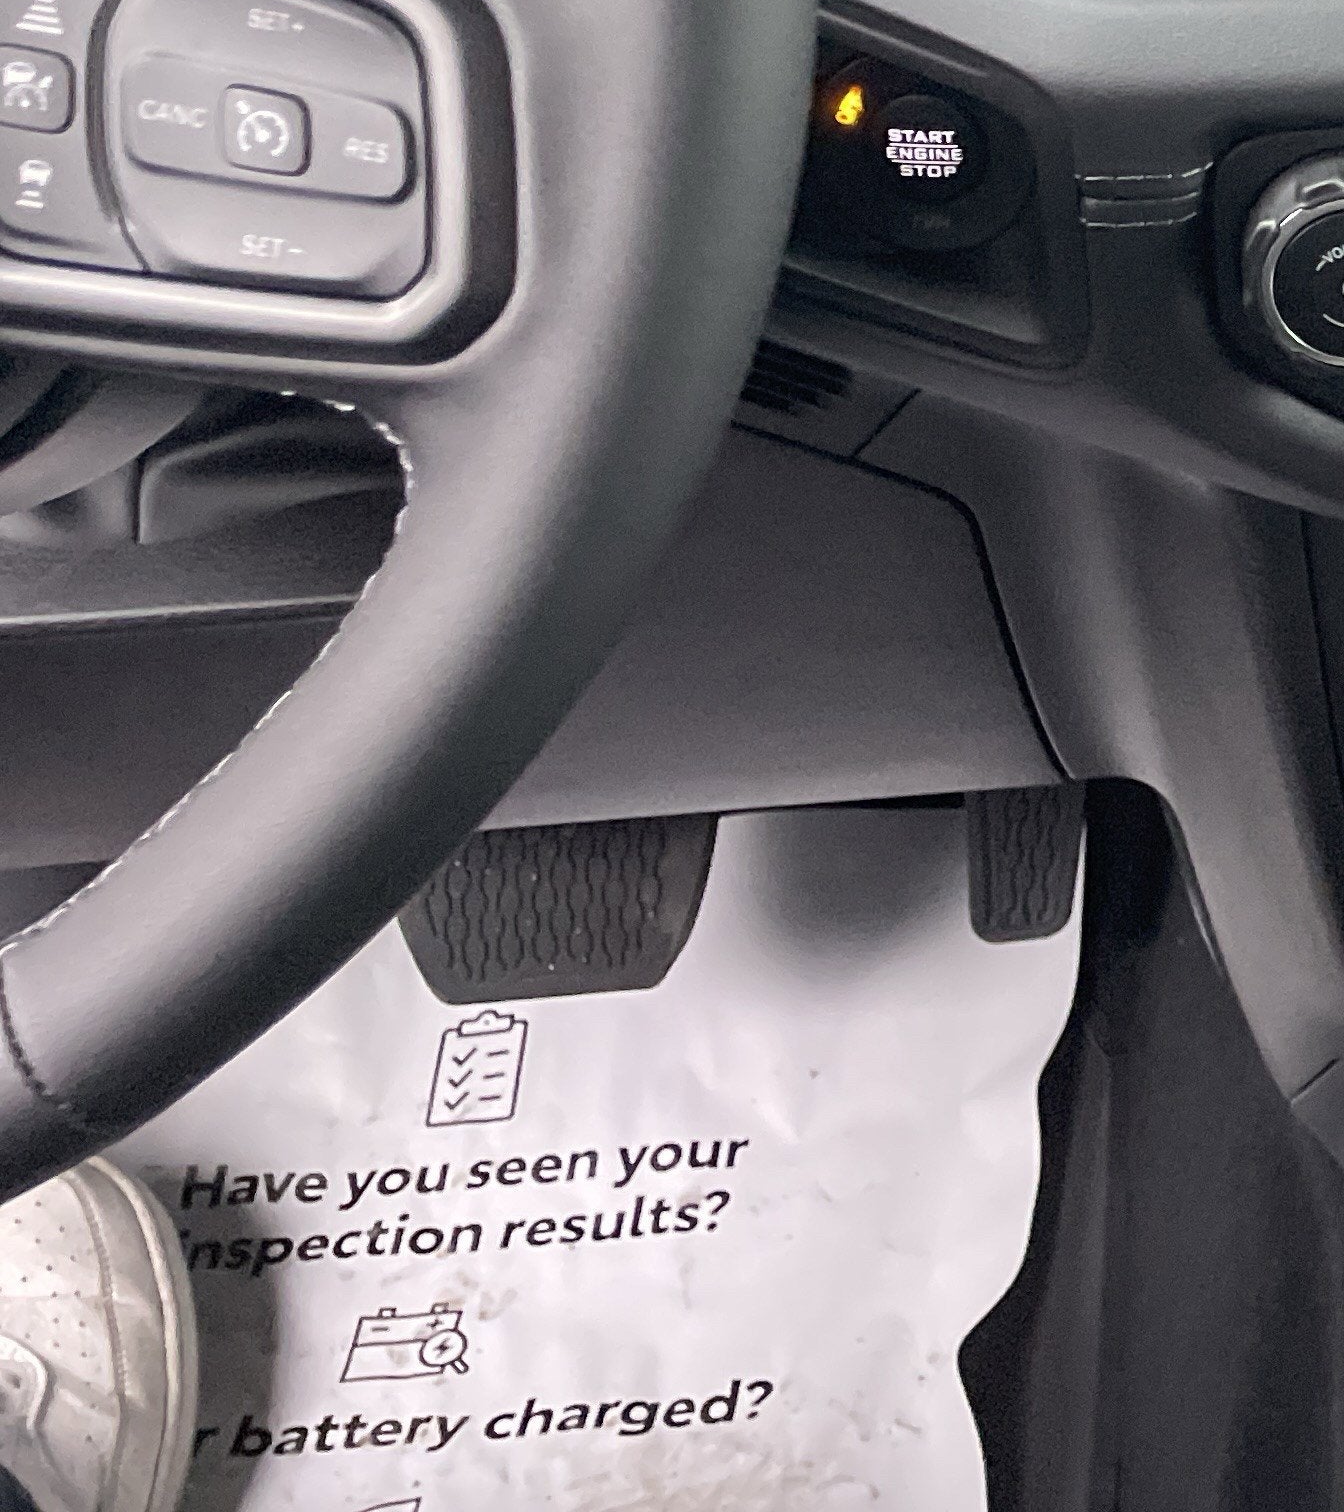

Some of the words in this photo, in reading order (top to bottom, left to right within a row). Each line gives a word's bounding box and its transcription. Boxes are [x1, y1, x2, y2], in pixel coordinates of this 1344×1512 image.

[137, 99, 208, 129] CANC
[887, 128, 956, 144] START
[342, 137, 390, 164] RES
[885, 146, 964, 161] ENGINE
[900, 164, 957, 178] STOP
[180, 1164, 328, 1211] Have
[338, 1162, 450, 1211] you
[466, 1149, 600, 1191] seen
[616, 1133, 750, 1186] your
[499, 1190, 730, 1252] results?
[229, 1413, 470, 1458] battery
[482, 1378, 774, 1438] charged?
